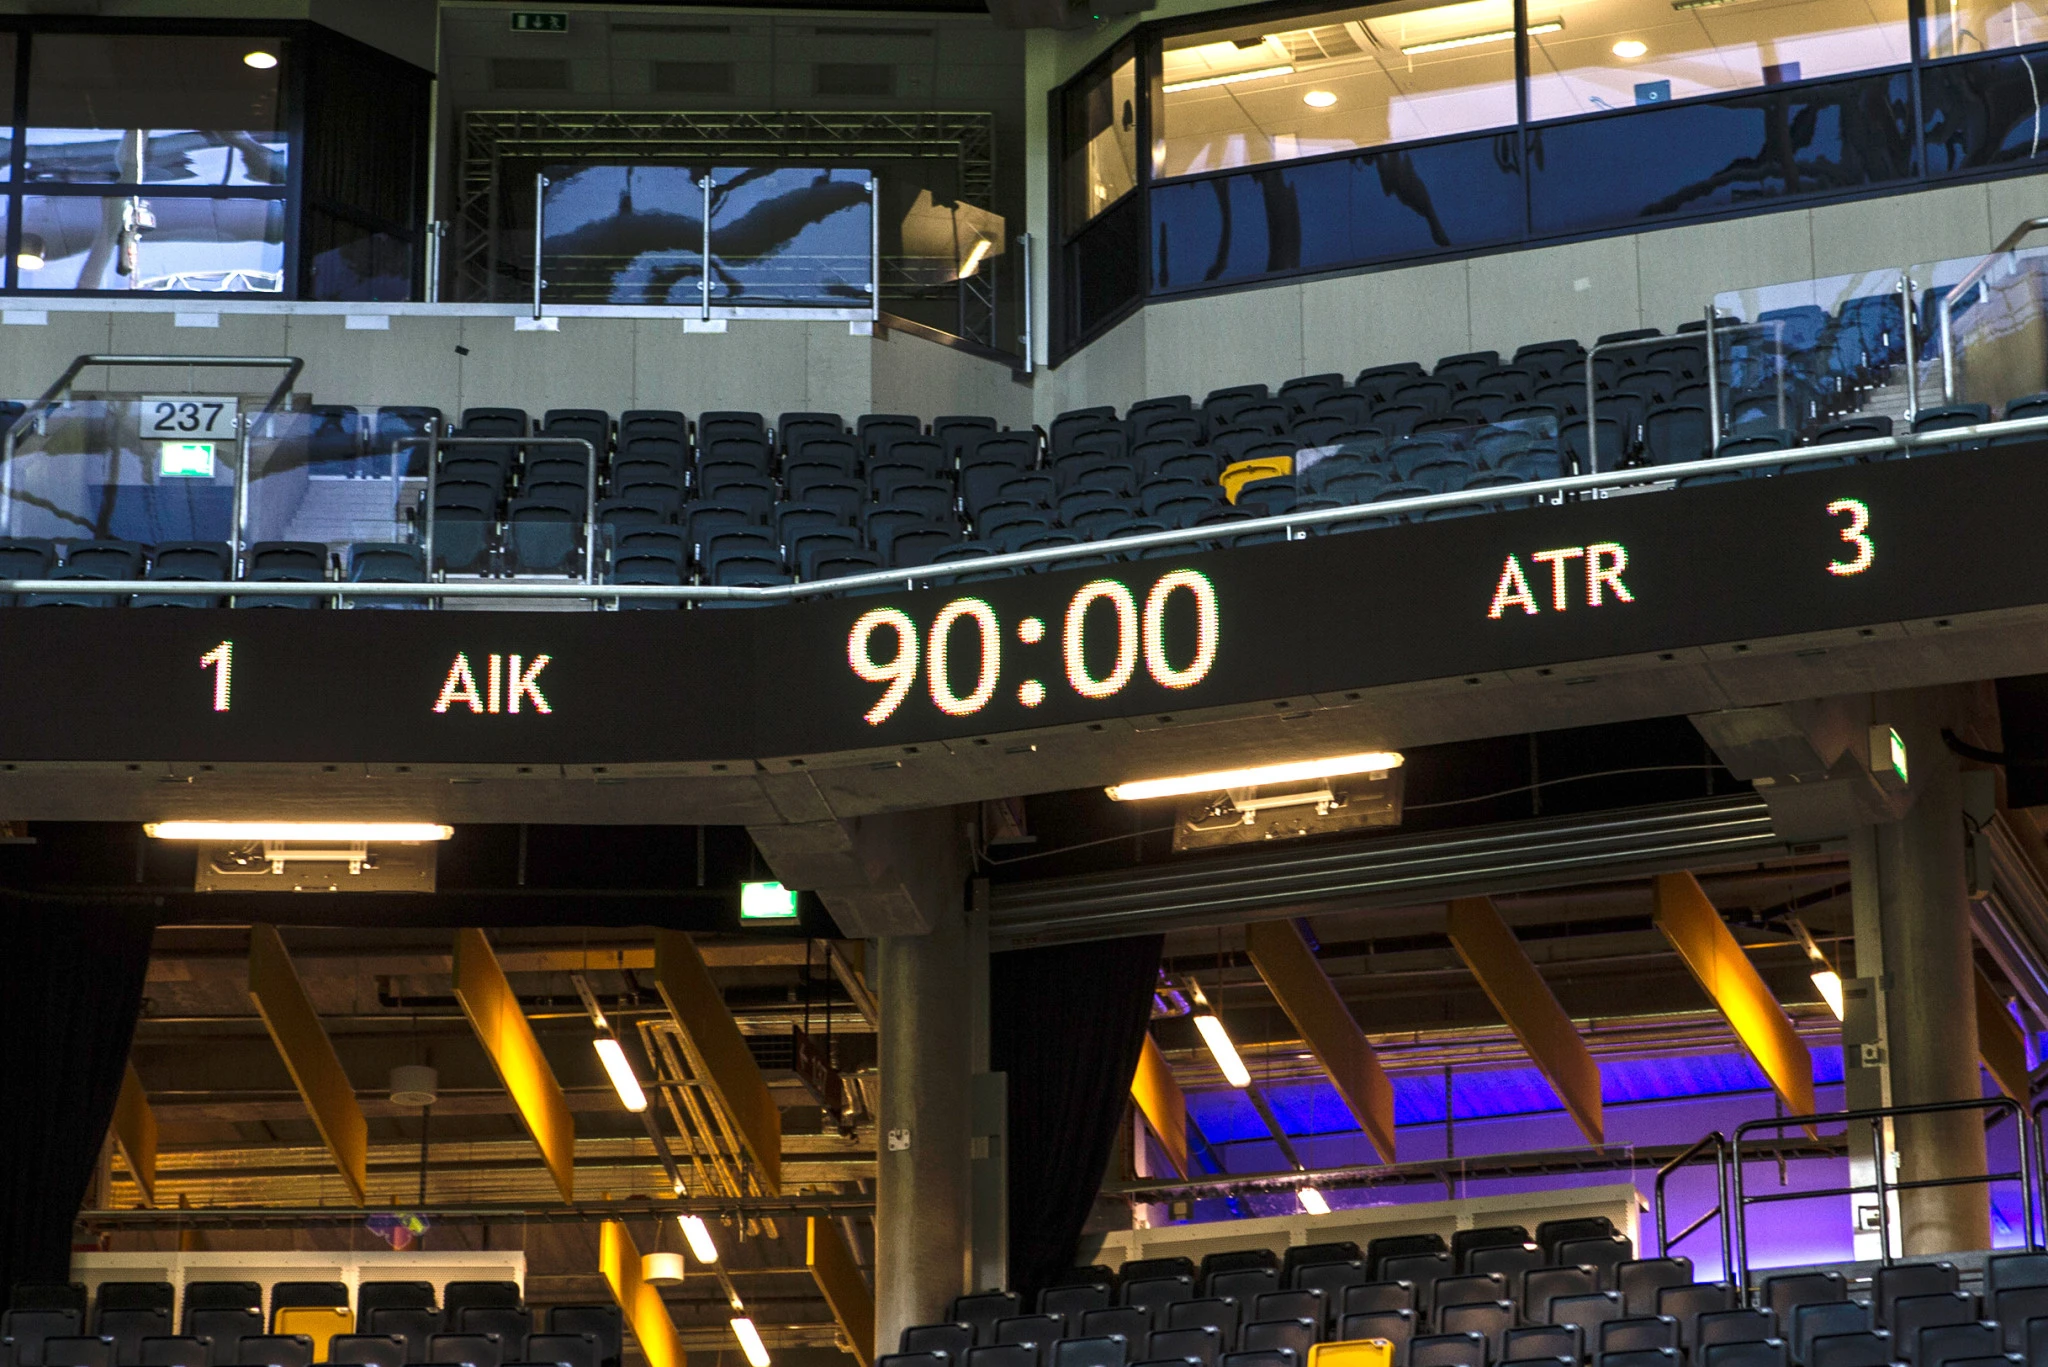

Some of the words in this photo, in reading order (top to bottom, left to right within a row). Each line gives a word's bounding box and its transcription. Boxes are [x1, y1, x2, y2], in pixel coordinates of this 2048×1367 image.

[154, 402, 224, 432] 237
[1487, 542, 1636, 619] ATR
[1826, 498, 1875, 576] 3
[200, 640, 232, 711] 1
[432, 651, 553, 713] AIK
[846, 568, 1221, 727] 90:00
